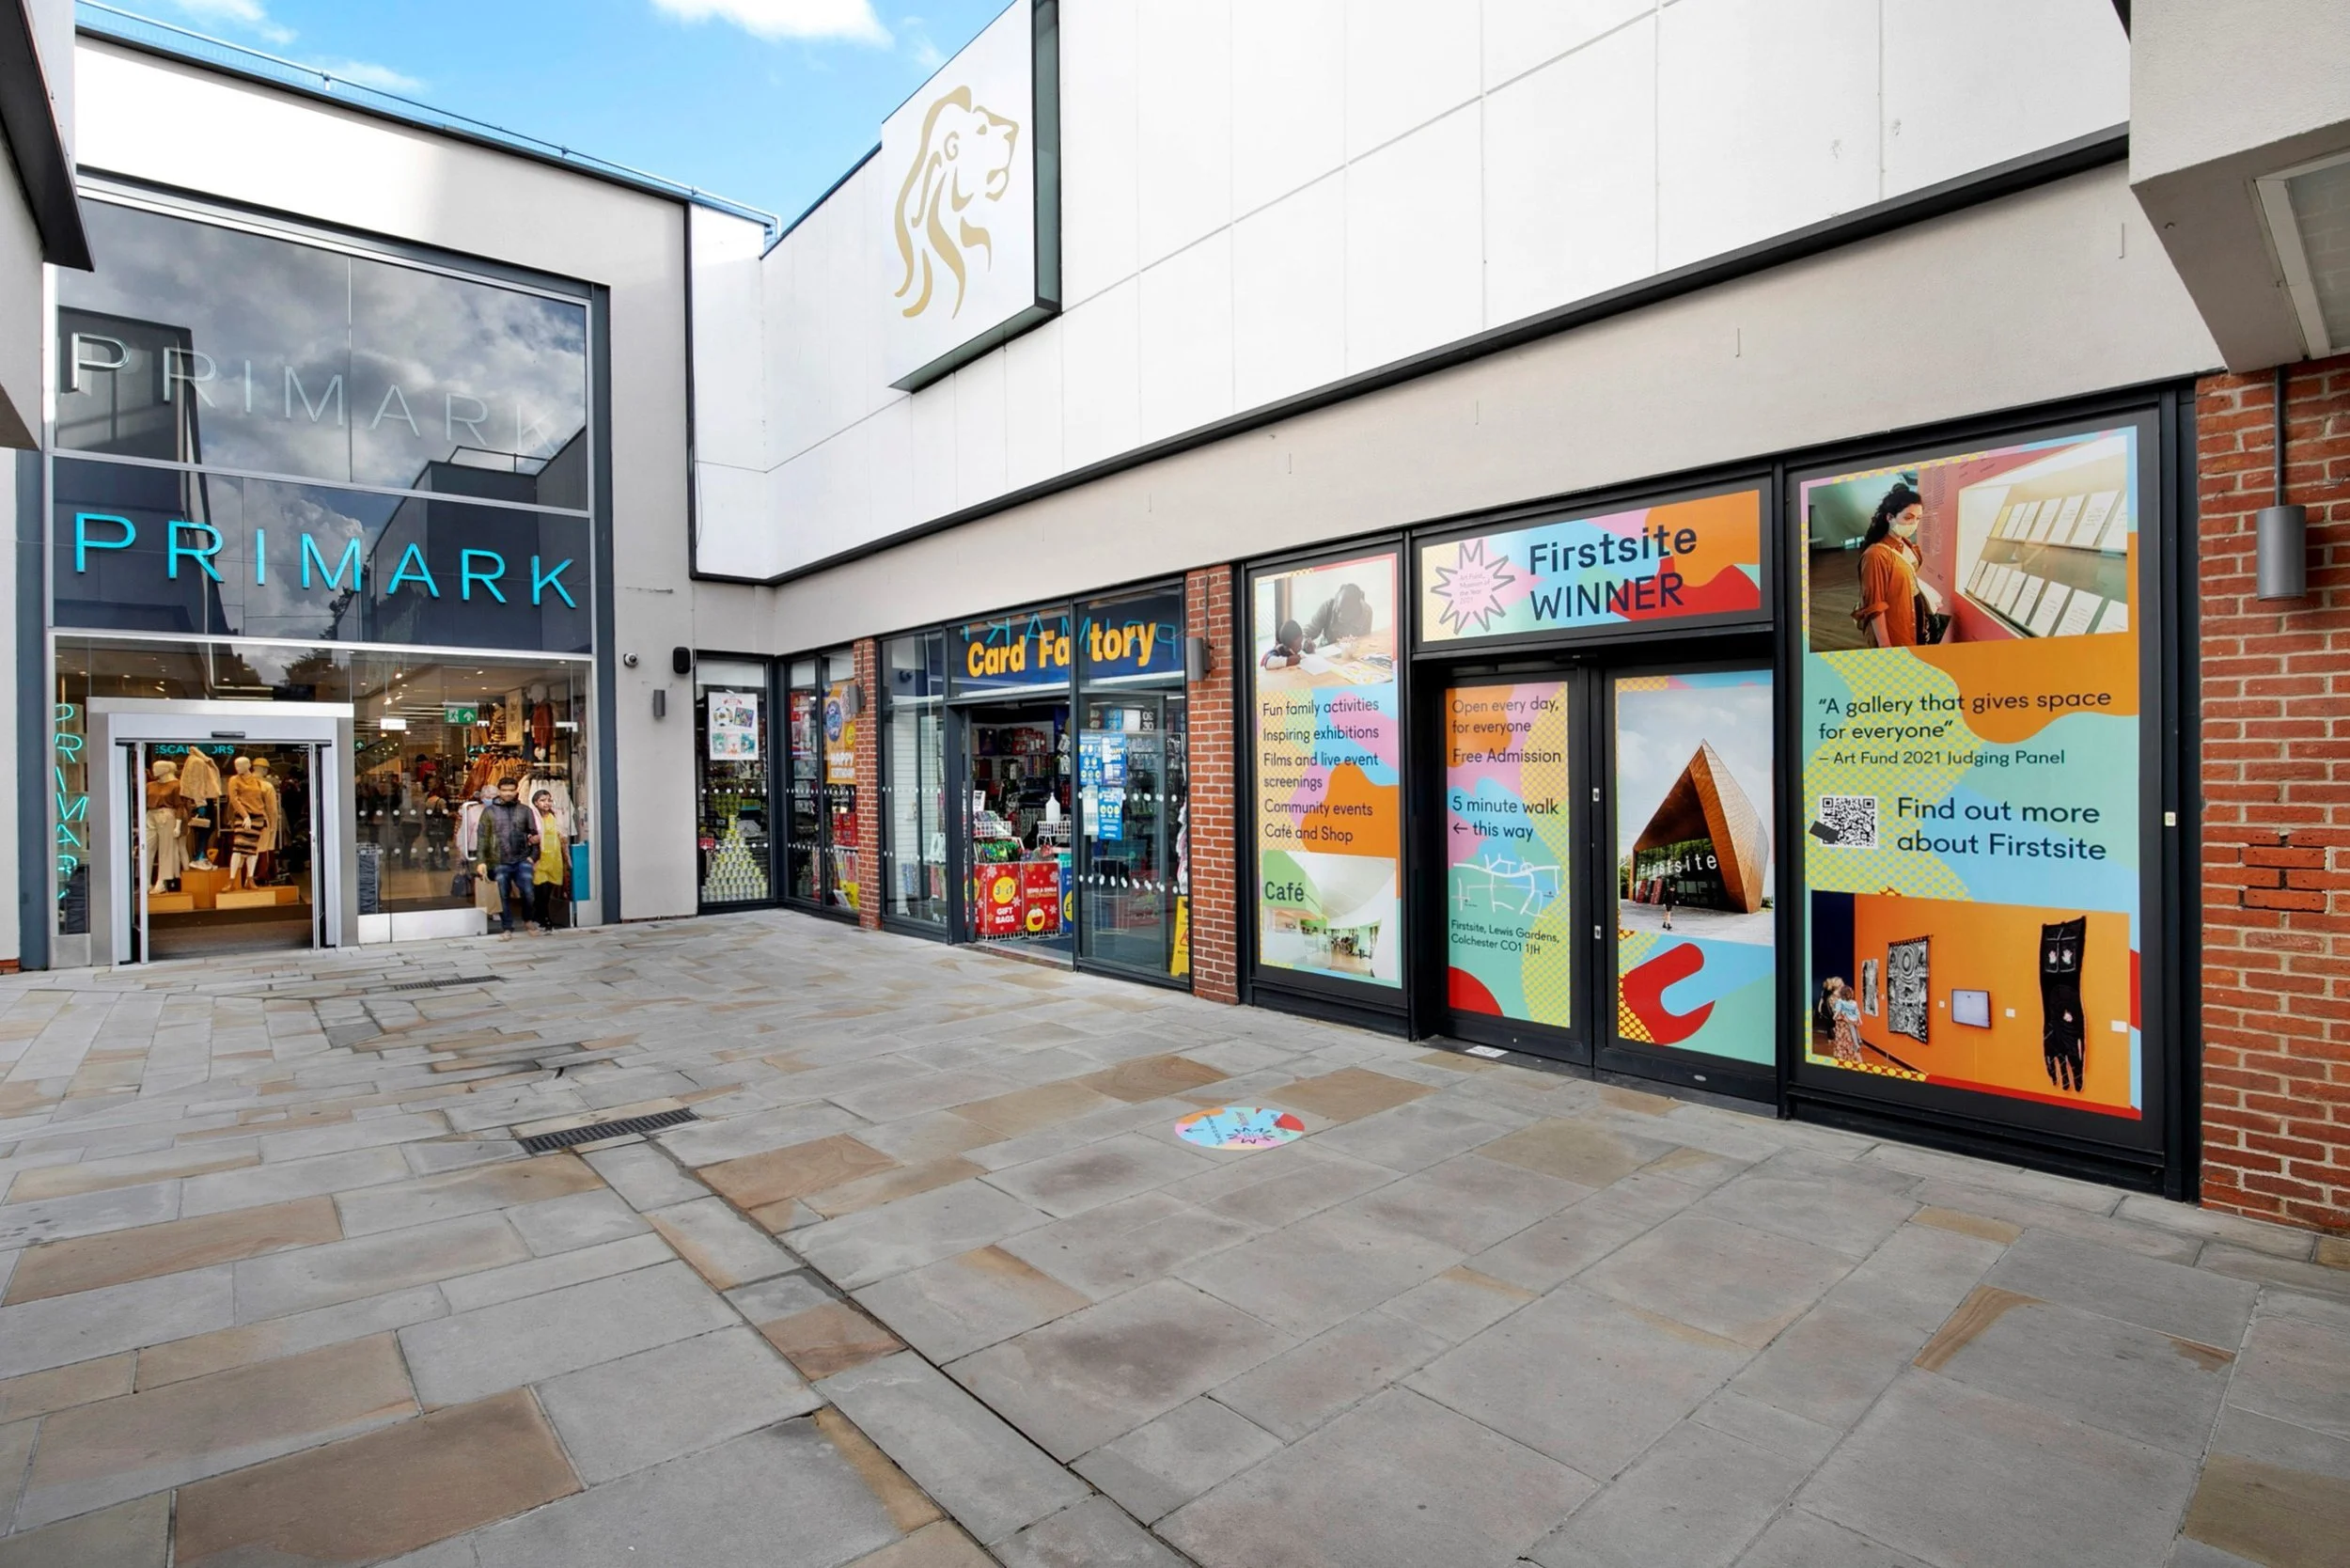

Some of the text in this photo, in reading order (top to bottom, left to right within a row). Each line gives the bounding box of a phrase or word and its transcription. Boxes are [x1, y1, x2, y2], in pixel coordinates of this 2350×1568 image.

[70, 332, 561, 457] PRIMARK
[1529, 525, 1697, 575] Firstsite
[74, 512, 578, 609] PRIMARK
[1529, 572, 1684, 621] WINNER
[967, 622, 1157, 678] Card Fatory
[1262, 698, 1379, 717] Fun family activities
[1452, 696, 1559, 716] Open every day,
[1846, 695, 1913, 717] gallery
[1919, 693, 1965, 712] that
[1972, 693, 2029, 714] gives
[2036, 692, 2112, 712] space
[1263, 725, 1379, 745] Inspiring exhibitions
[1452, 719, 1531, 736] for everyone
[1818, 722, 1846, 740] for
[1263, 752, 1379, 766] Films and live event
[1452, 747, 1561, 763] Free Admission
[1833, 752, 1856, 765] Art
[1860, 751, 1898, 764] Fund
[1904, 751, 1941, 764] 2021
[1948, 750, 2010, 767] Judging
[2015, 749, 2065, 764] Panel
[1263, 776, 1323, 792] screenings
[1264, 799, 1373, 818] Community events
[1452, 795, 1559, 815] 5 minute walk
[1897, 796, 2100, 823] Find out more
[1264, 823, 1354, 846] Café and Shop
[1473, 820, 1534, 843] this way
[1897, 829, 2107, 860] about Firstsite
[1264, 881, 1305, 902] Café
[995, 914, 1015, 924] BAGS
[996, 906, 1013, 916] GIFT
[1450, 919, 1560, 944] Firstsite, Lewis Gardens,
[1450, 933, 1497, 949] Colchester
[1500, 939, 1522, 952] CO1
